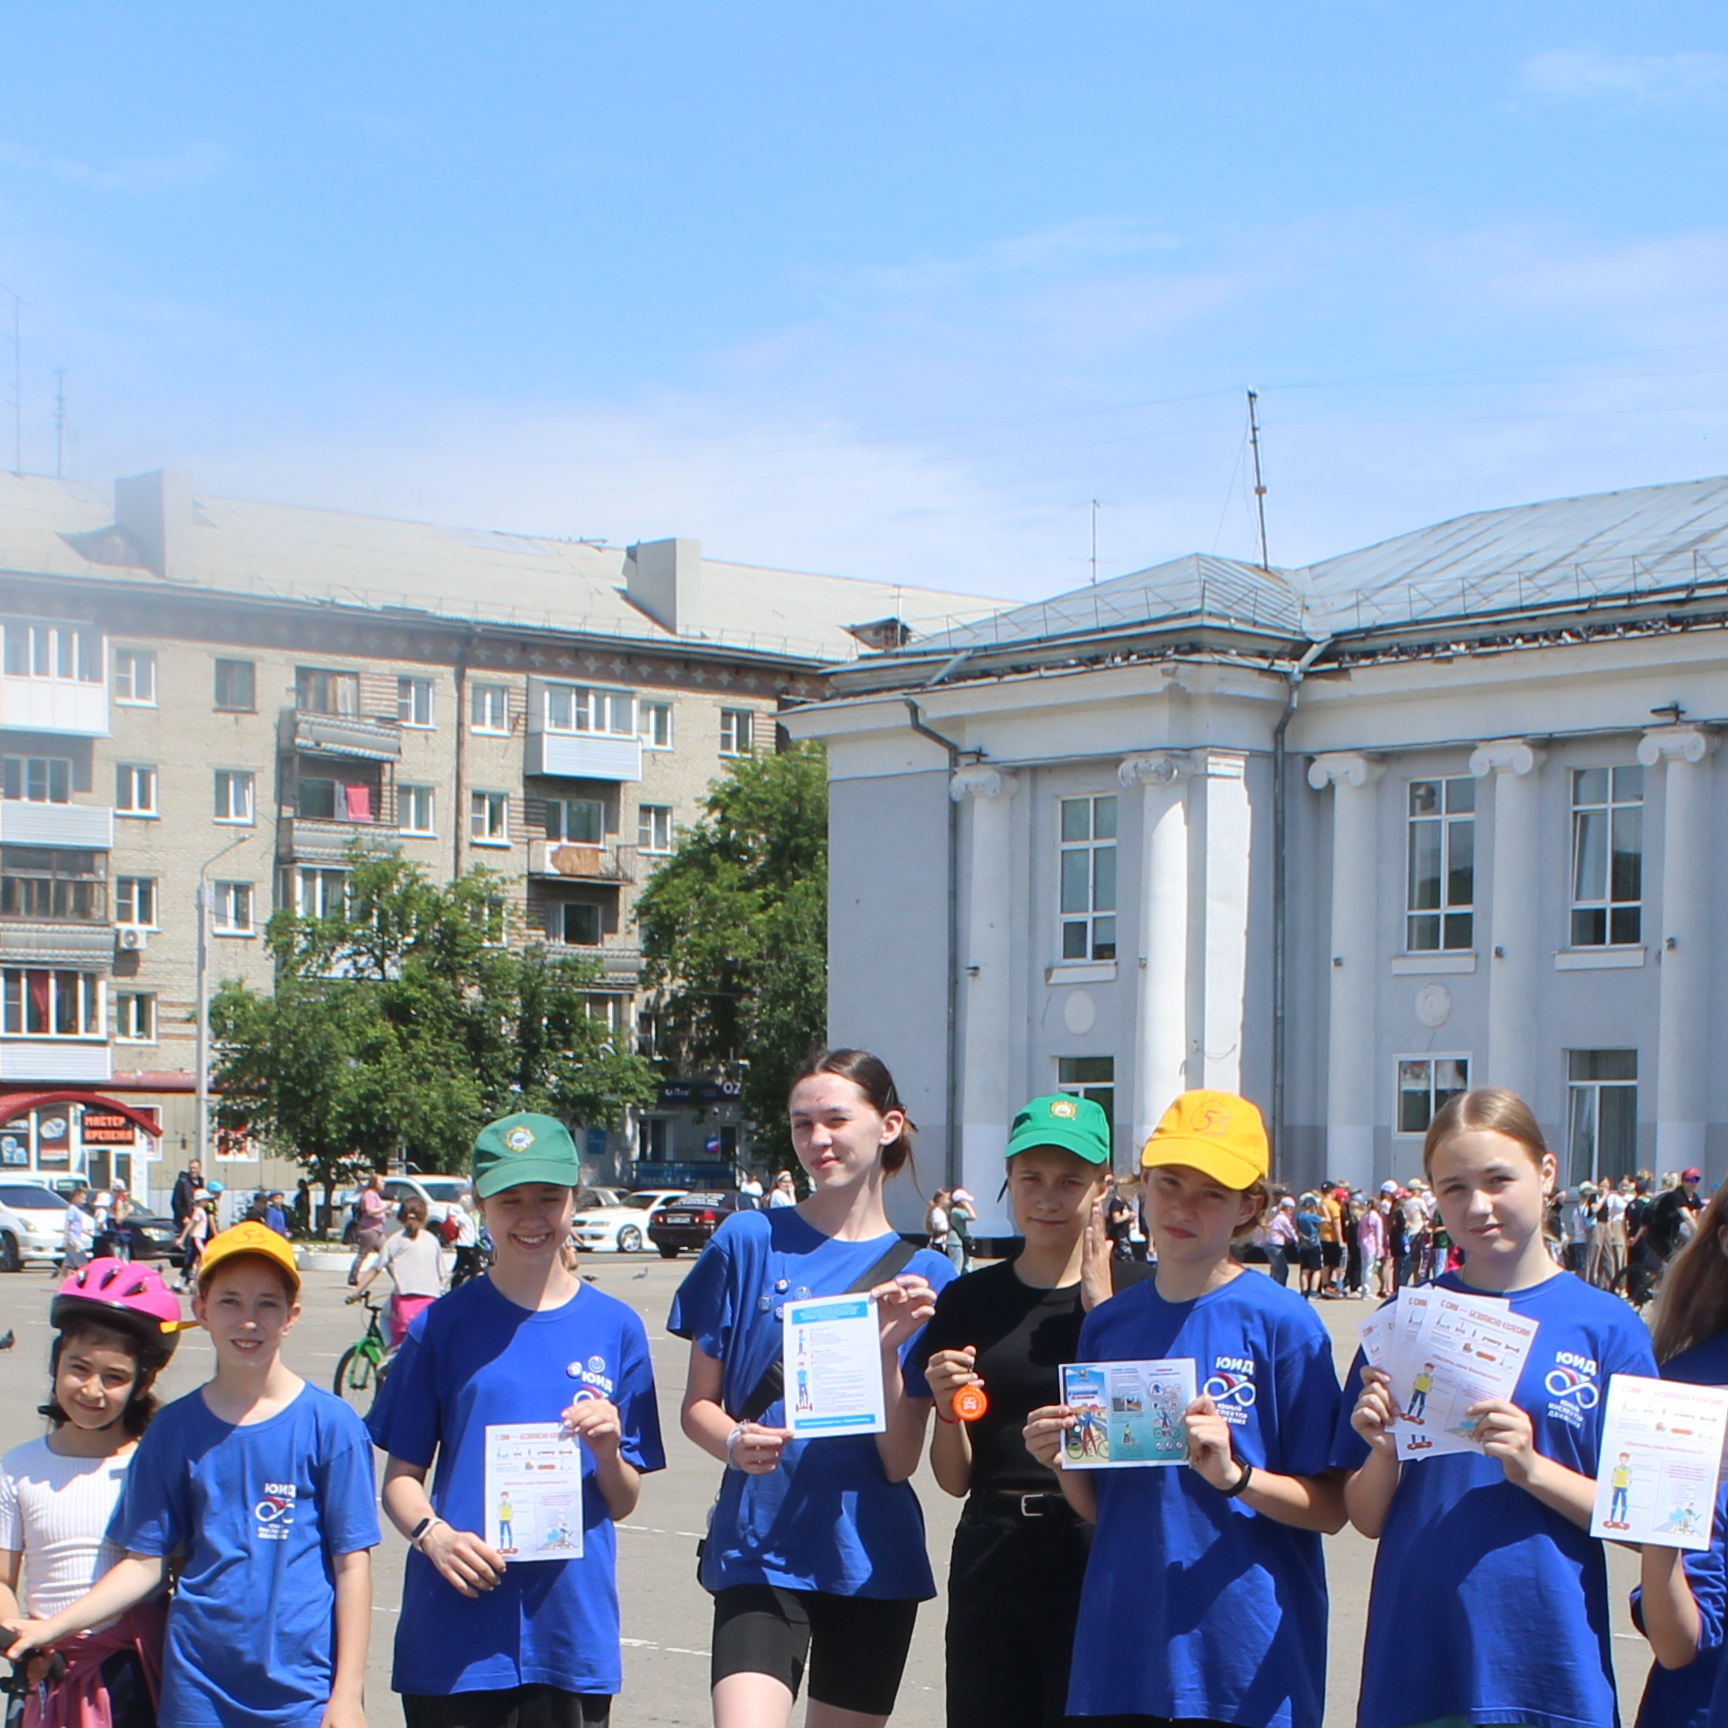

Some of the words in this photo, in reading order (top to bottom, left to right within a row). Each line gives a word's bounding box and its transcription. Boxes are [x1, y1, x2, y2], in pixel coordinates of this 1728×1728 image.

[83, 1115, 126, 1127] МАСТЕР
[1215, 1356, 1255, 1376] ЮИД
[1555, 1351, 1598, 1376] ЮИД
[582, 1371, 613, 1393] ЮИД
